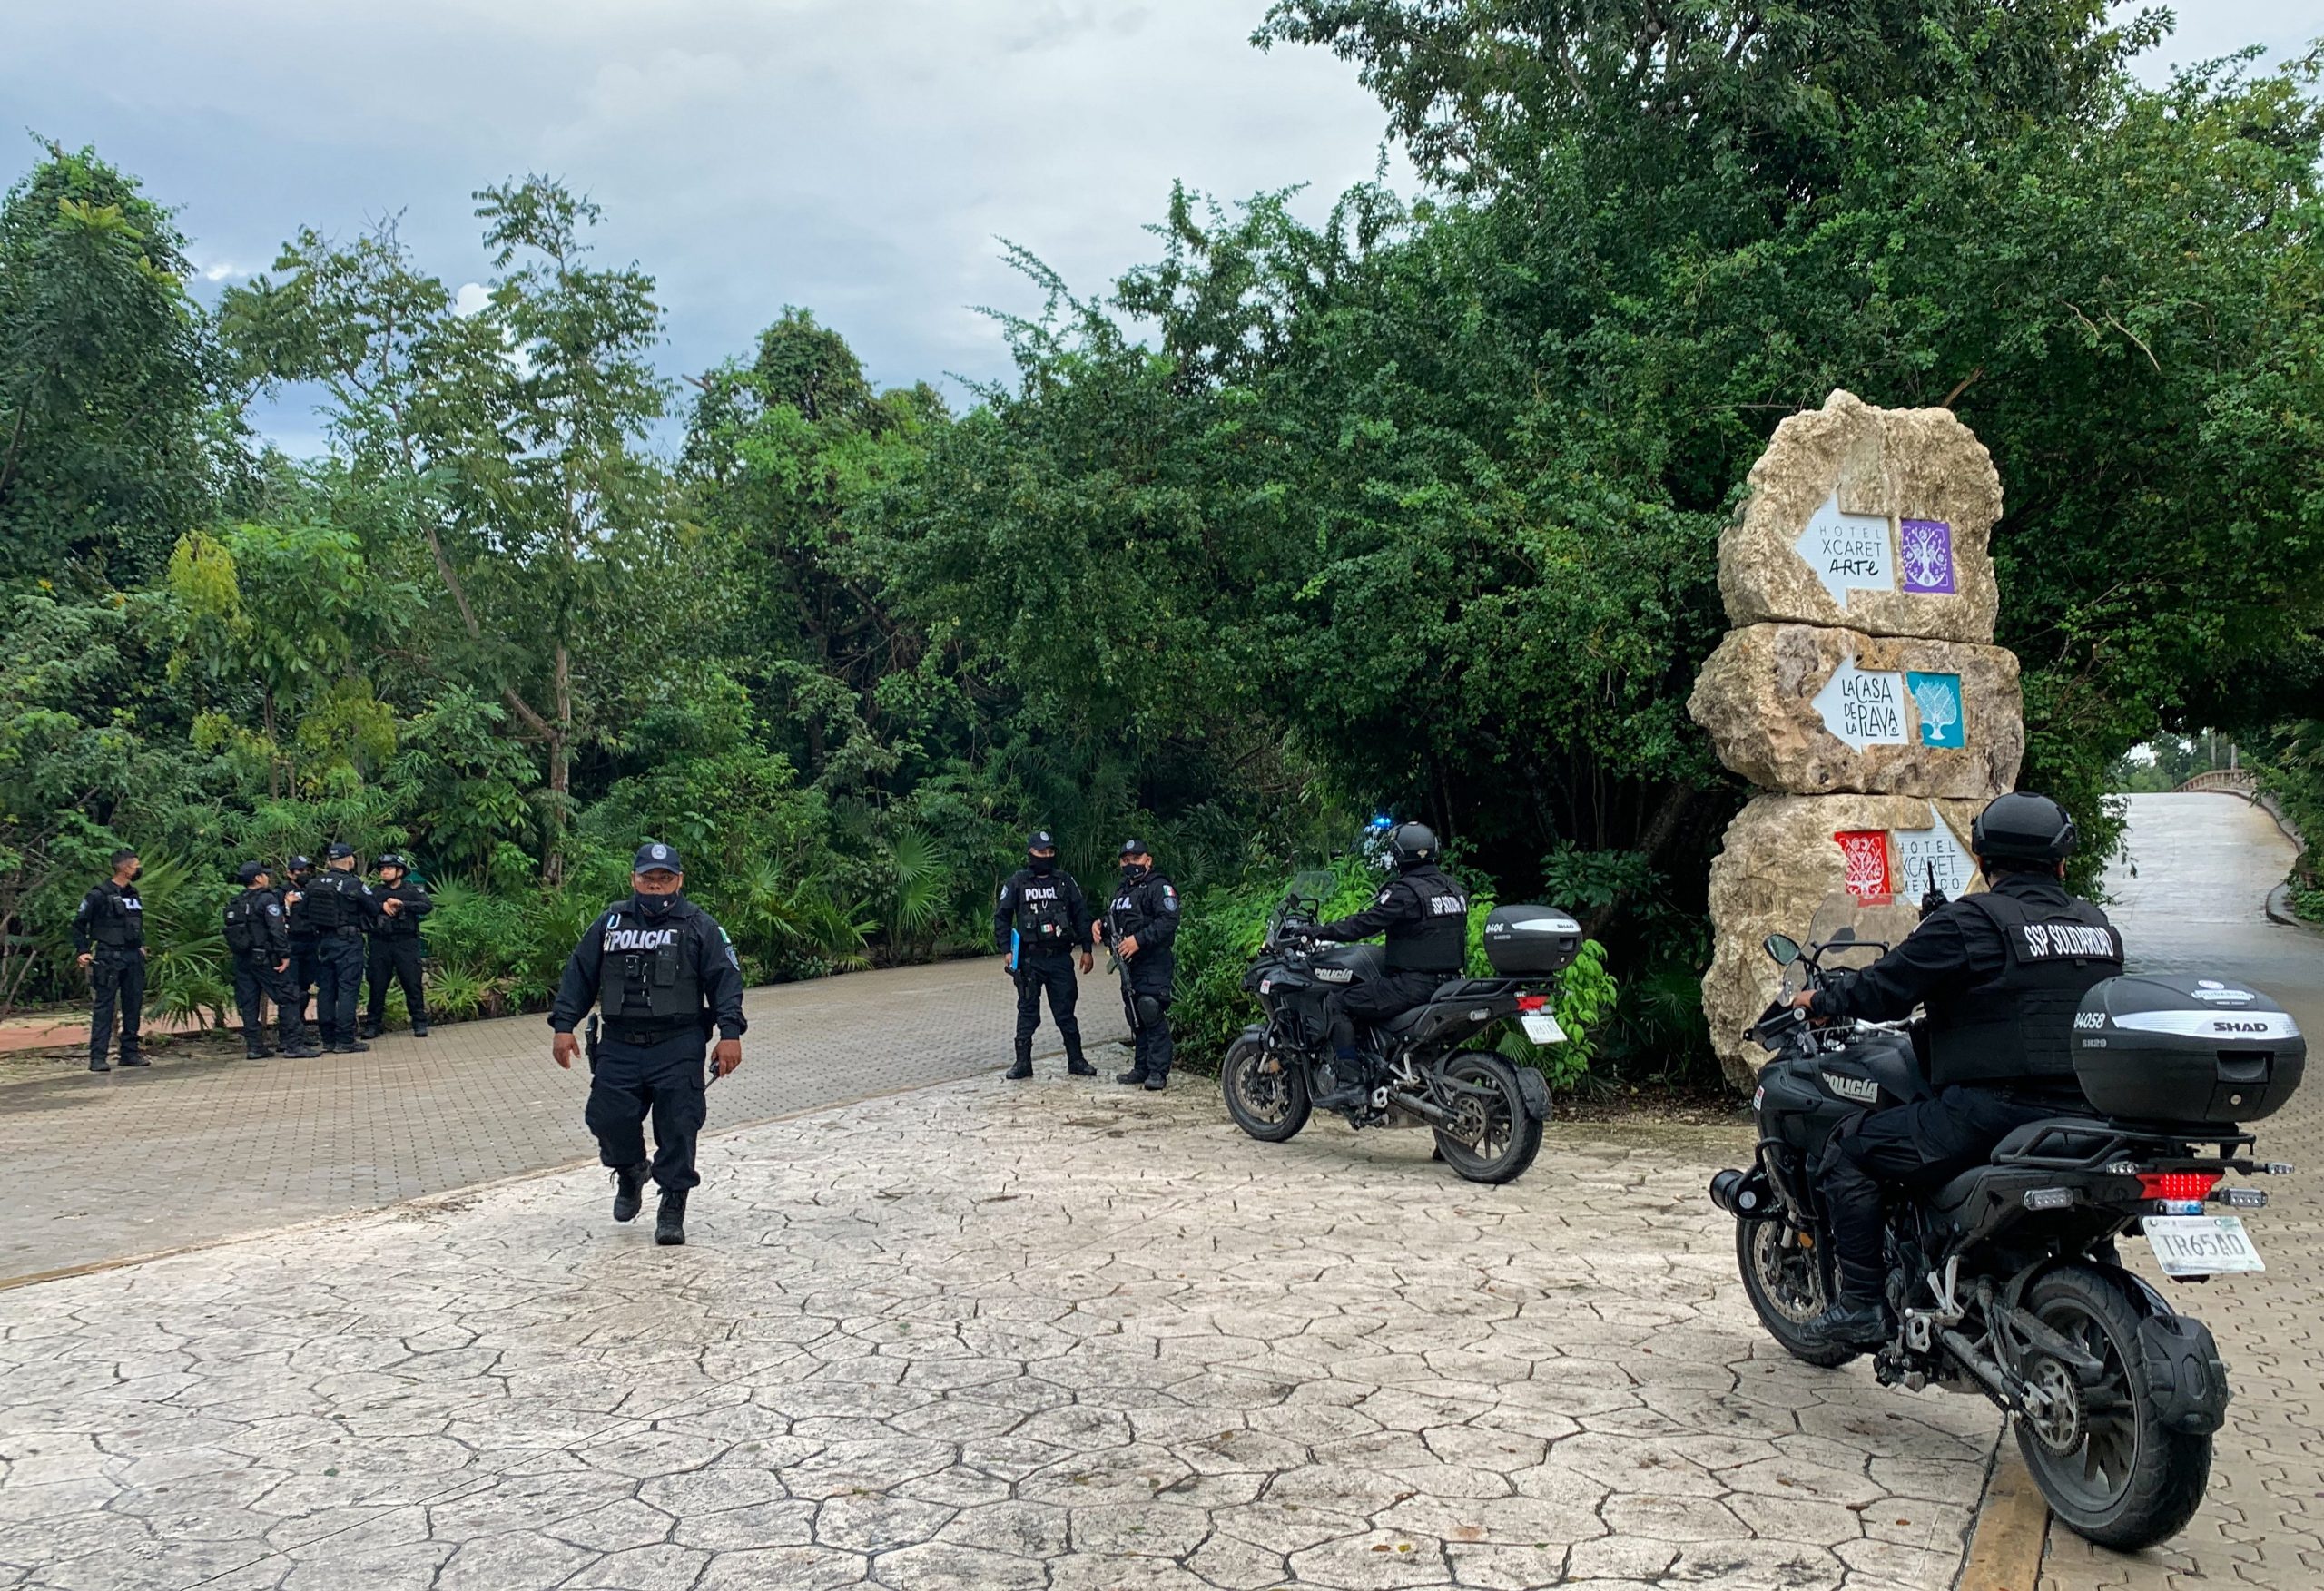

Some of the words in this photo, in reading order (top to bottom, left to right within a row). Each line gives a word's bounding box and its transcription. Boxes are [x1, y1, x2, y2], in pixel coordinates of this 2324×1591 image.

[1819, 526, 1881, 539] HOTEL
[1822, 539, 1882, 557] XCARET
[1842, 679, 1855, 696] LA
[1856, 674, 1894, 704] CASA
[1844, 702, 1856, 720] DE
[1846, 722, 1857, 735] LA
[1857, 704, 1900, 737] PLAYA
[2024, 925, 2050, 957] SSP
[2213, 1022, 2269, 1032] SHAD
